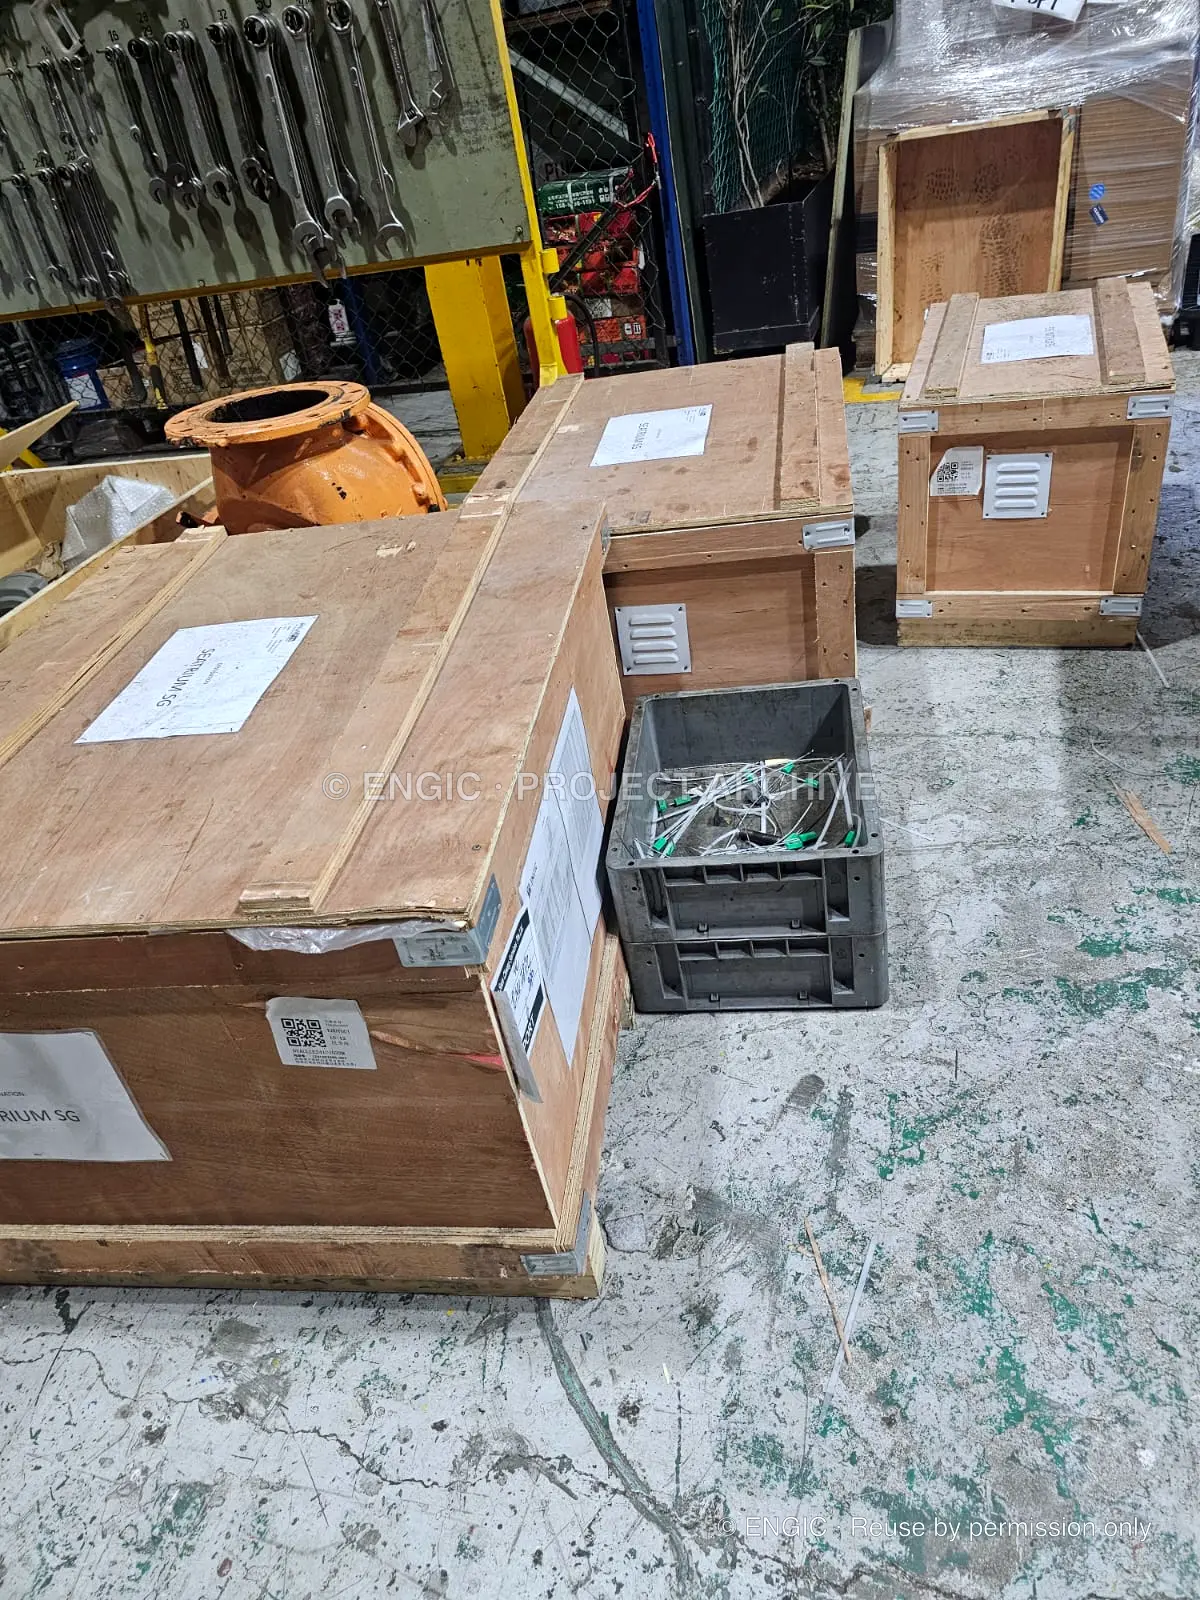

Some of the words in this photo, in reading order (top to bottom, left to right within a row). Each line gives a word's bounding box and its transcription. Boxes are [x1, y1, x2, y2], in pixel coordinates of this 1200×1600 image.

[168, 648, 215, 692] SEATRIUM
[156, 694, 177, 707] SG
[54, 1109, 81, 1122] SG
